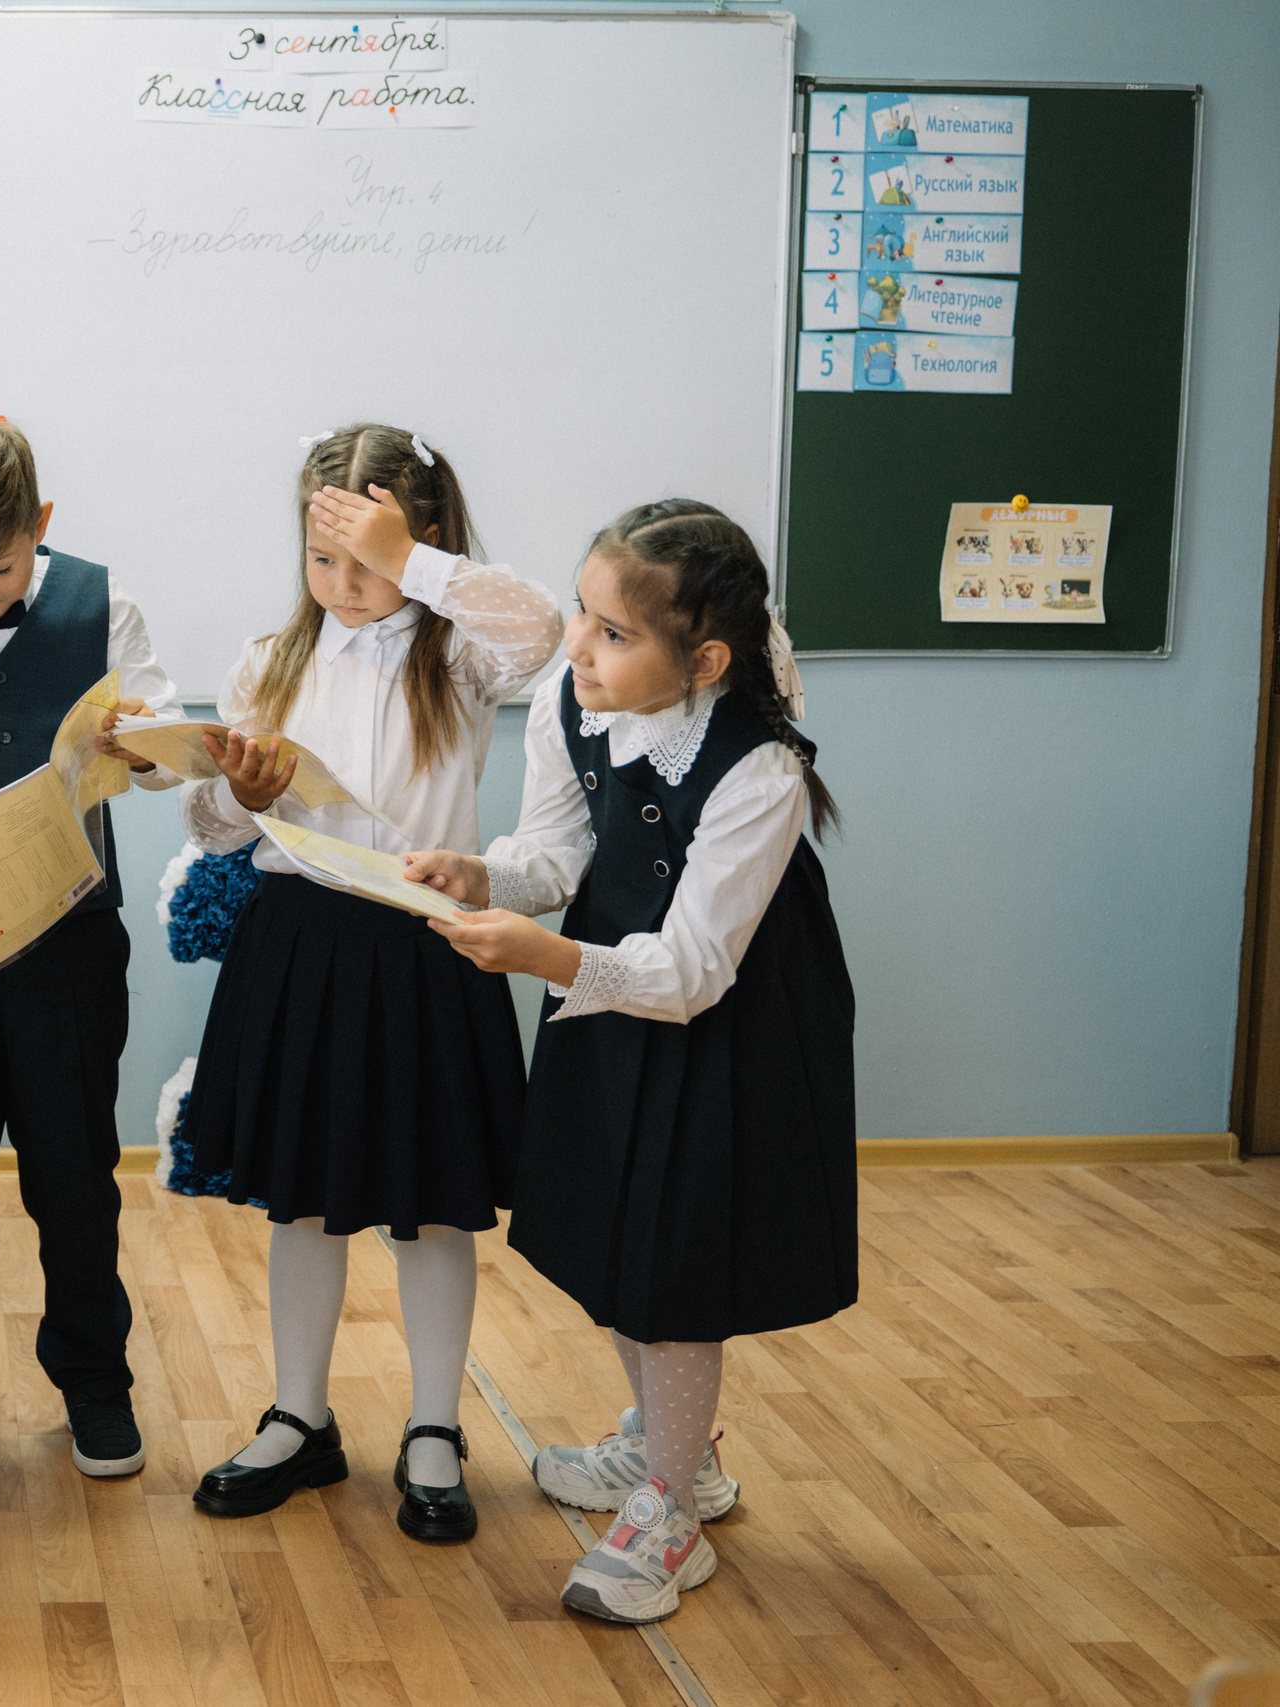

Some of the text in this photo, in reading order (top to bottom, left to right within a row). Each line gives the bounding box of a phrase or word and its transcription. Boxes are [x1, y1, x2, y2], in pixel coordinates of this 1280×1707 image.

[229, 27, 256, 60] 3
[139, 74, 306, 113] Классная
[831, 108, 841, 137] 1
[925, 115, 1014, 135] Математика
[345, 154, 444, 226] Упр. 4
[830, 168, 845, 196] 2
[914, 173, 1019, 196] Русский язык
[828, 227, 840, 256] 3
[922, 224, 1009, 244] Английский
[945, 249, 986, 263] язык
[824, 287, 839, 314] 4
[907, 284, 1003, 311] Литературное
[930, 310, 982, 327] чтение
[820, 349, 834, 377] 5
[912, 353, 998, 374] Технология
[989, 508, 1068, 521] ДЕЖУРНЫЕ
